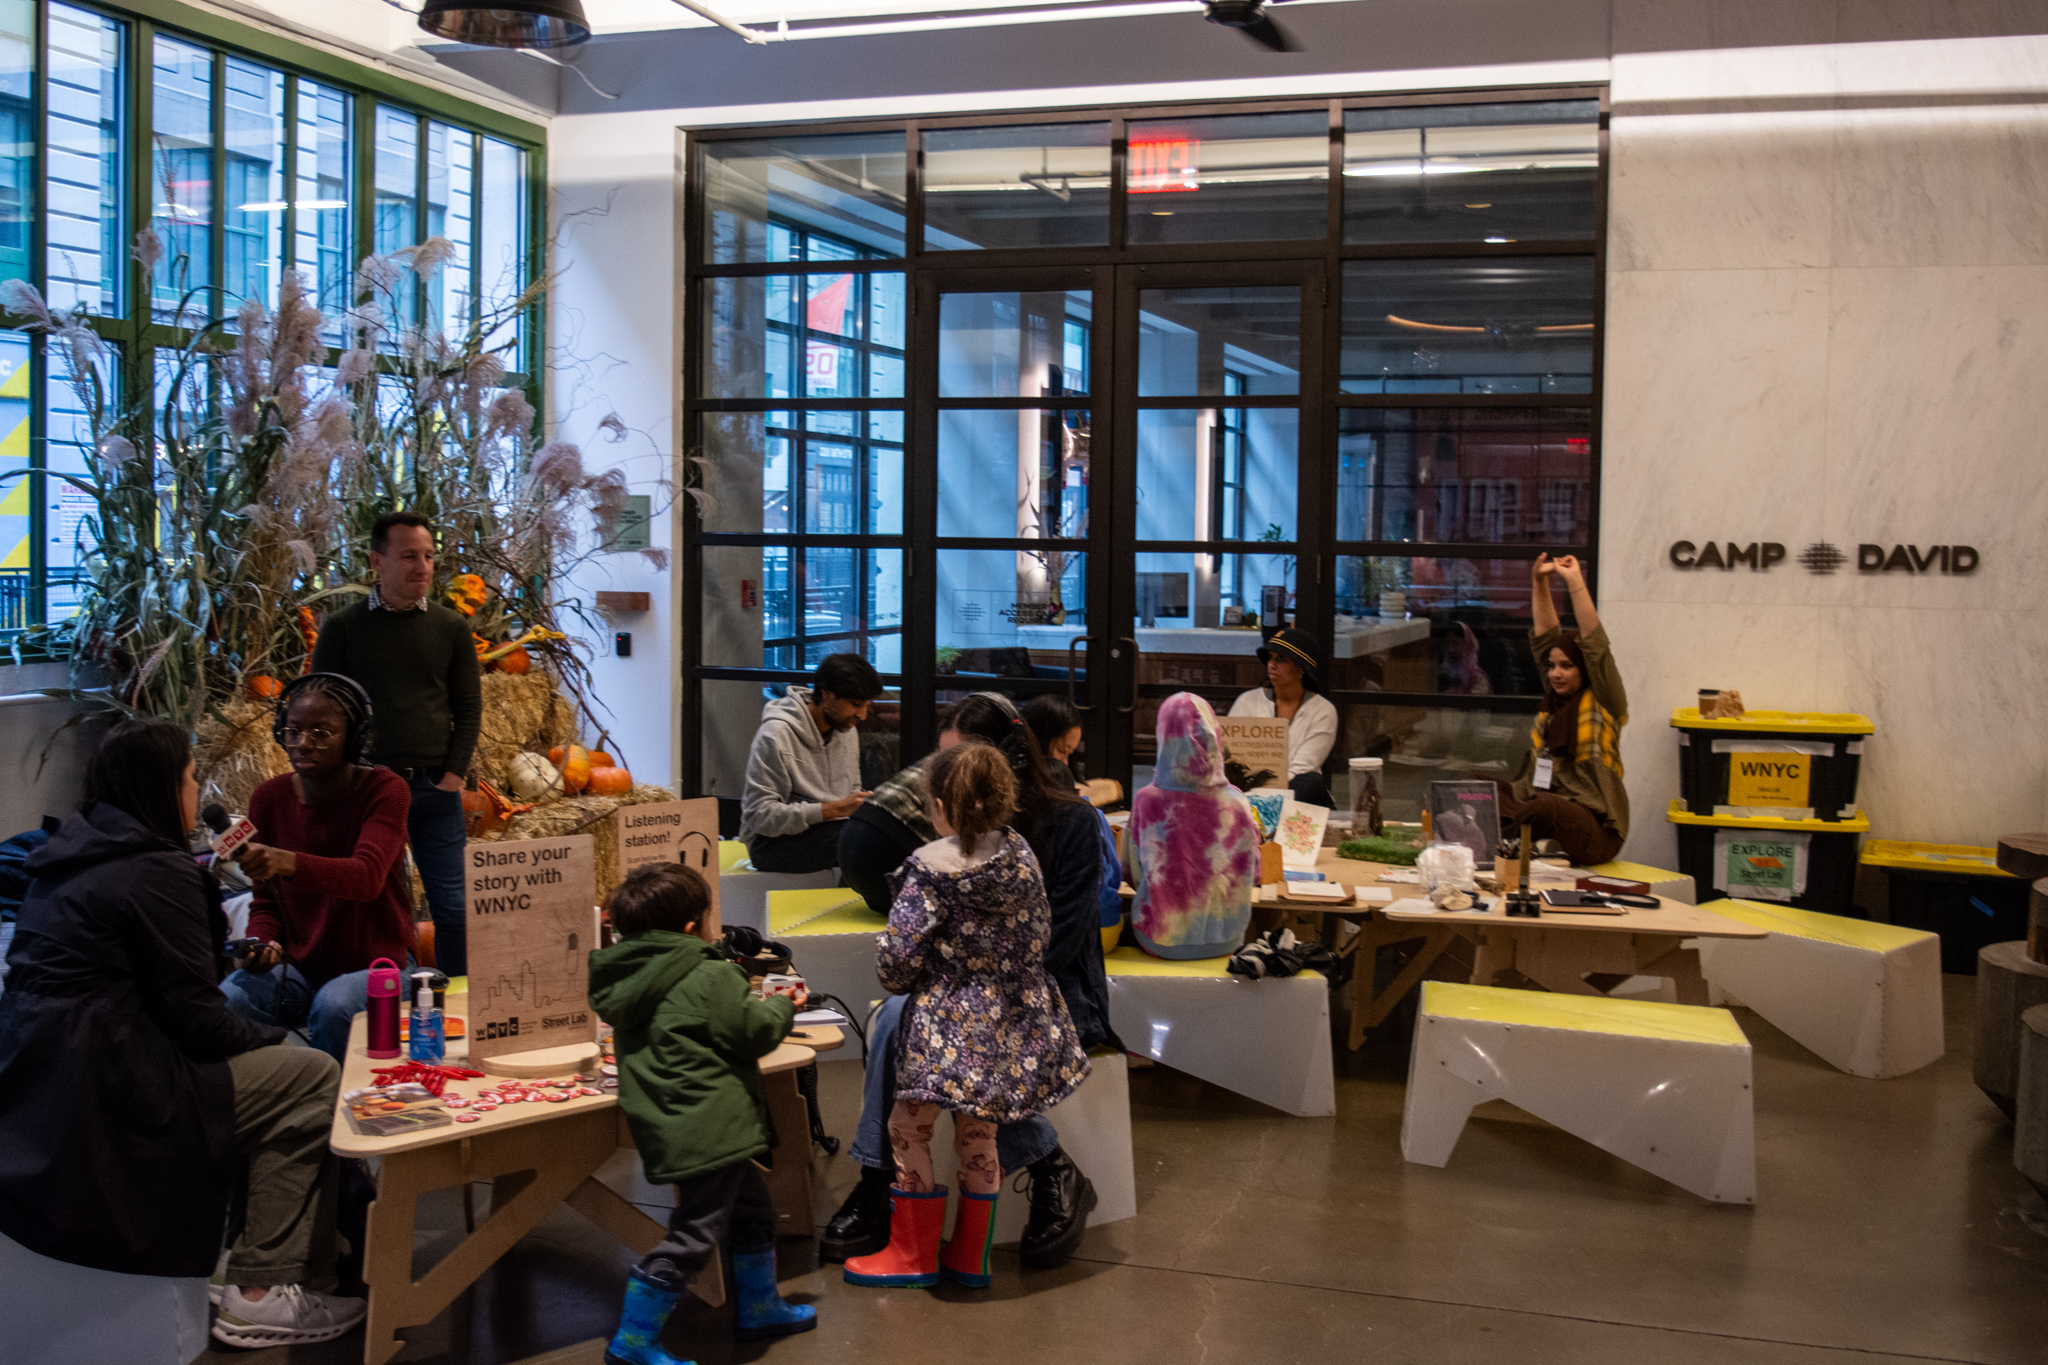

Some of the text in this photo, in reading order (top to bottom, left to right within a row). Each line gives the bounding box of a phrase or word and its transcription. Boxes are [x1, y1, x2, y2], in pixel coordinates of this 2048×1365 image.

[1669, 540, 1980, 573] CAMP DAVID
[1220, 724, 1285, 739] XPLORE
[1740, 762, 1800, 779] WNYC
[625, 812, 681, 829] Listening
[625, 831, 671, 848] station!
[473, 847, 572, 868] Share your
[1732, 844, 1794, 858] EXPLORE
[474, 868, 562, 892] story with
[1767, 870, 1783, 881] Lab
[474, 894, 531, 915] WNYC
[476, 1019, 519, 1039] WNYC
[542, 1016, 570, 1029] Street
[571, 1013, 588, 1024] Lab
